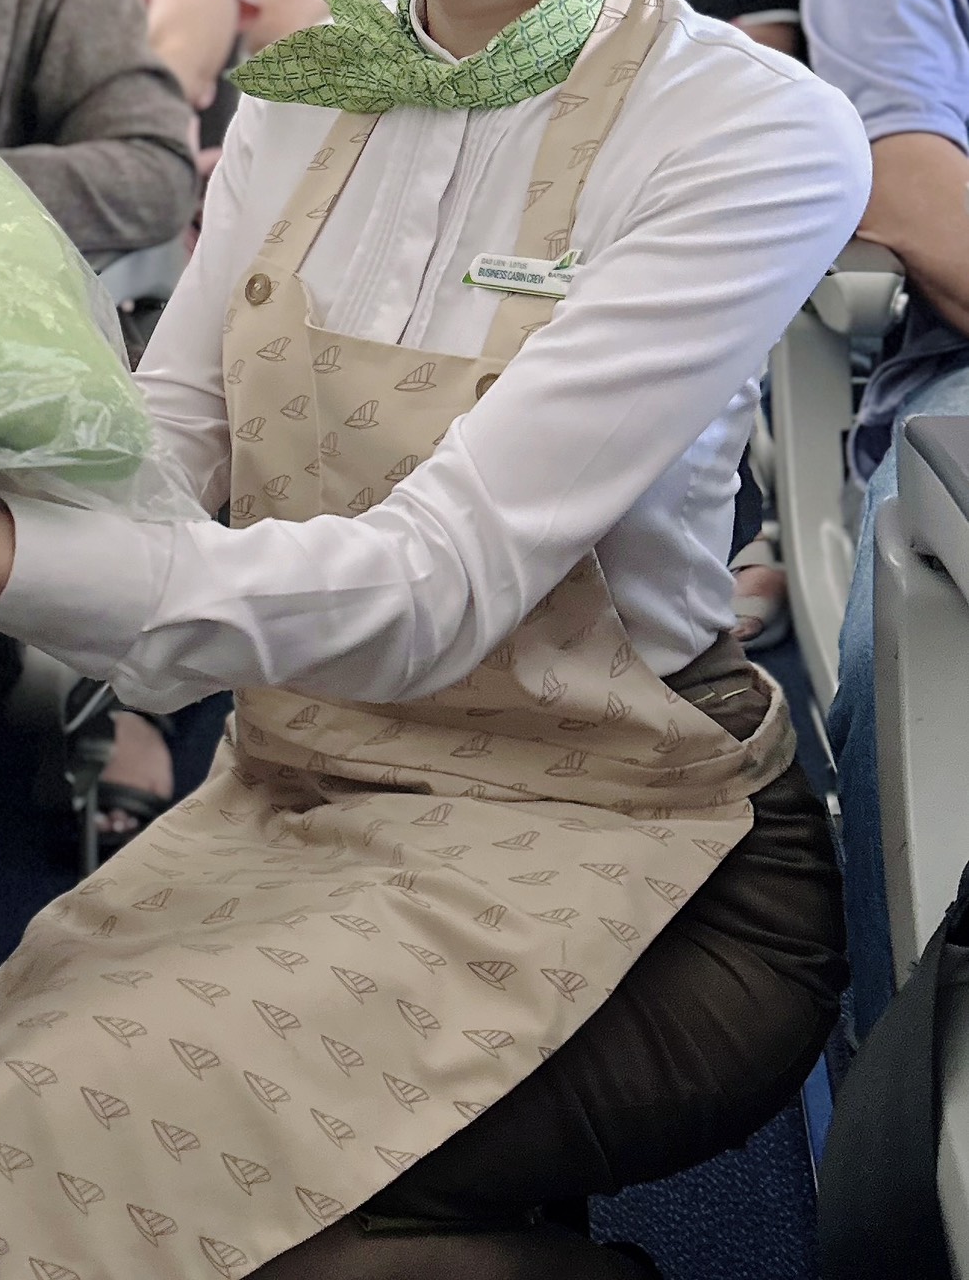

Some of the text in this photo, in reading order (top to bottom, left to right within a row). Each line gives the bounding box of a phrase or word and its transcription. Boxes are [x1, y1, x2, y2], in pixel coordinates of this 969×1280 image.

[477, 267, 545, 284] BUSINESS CABIN CREW
